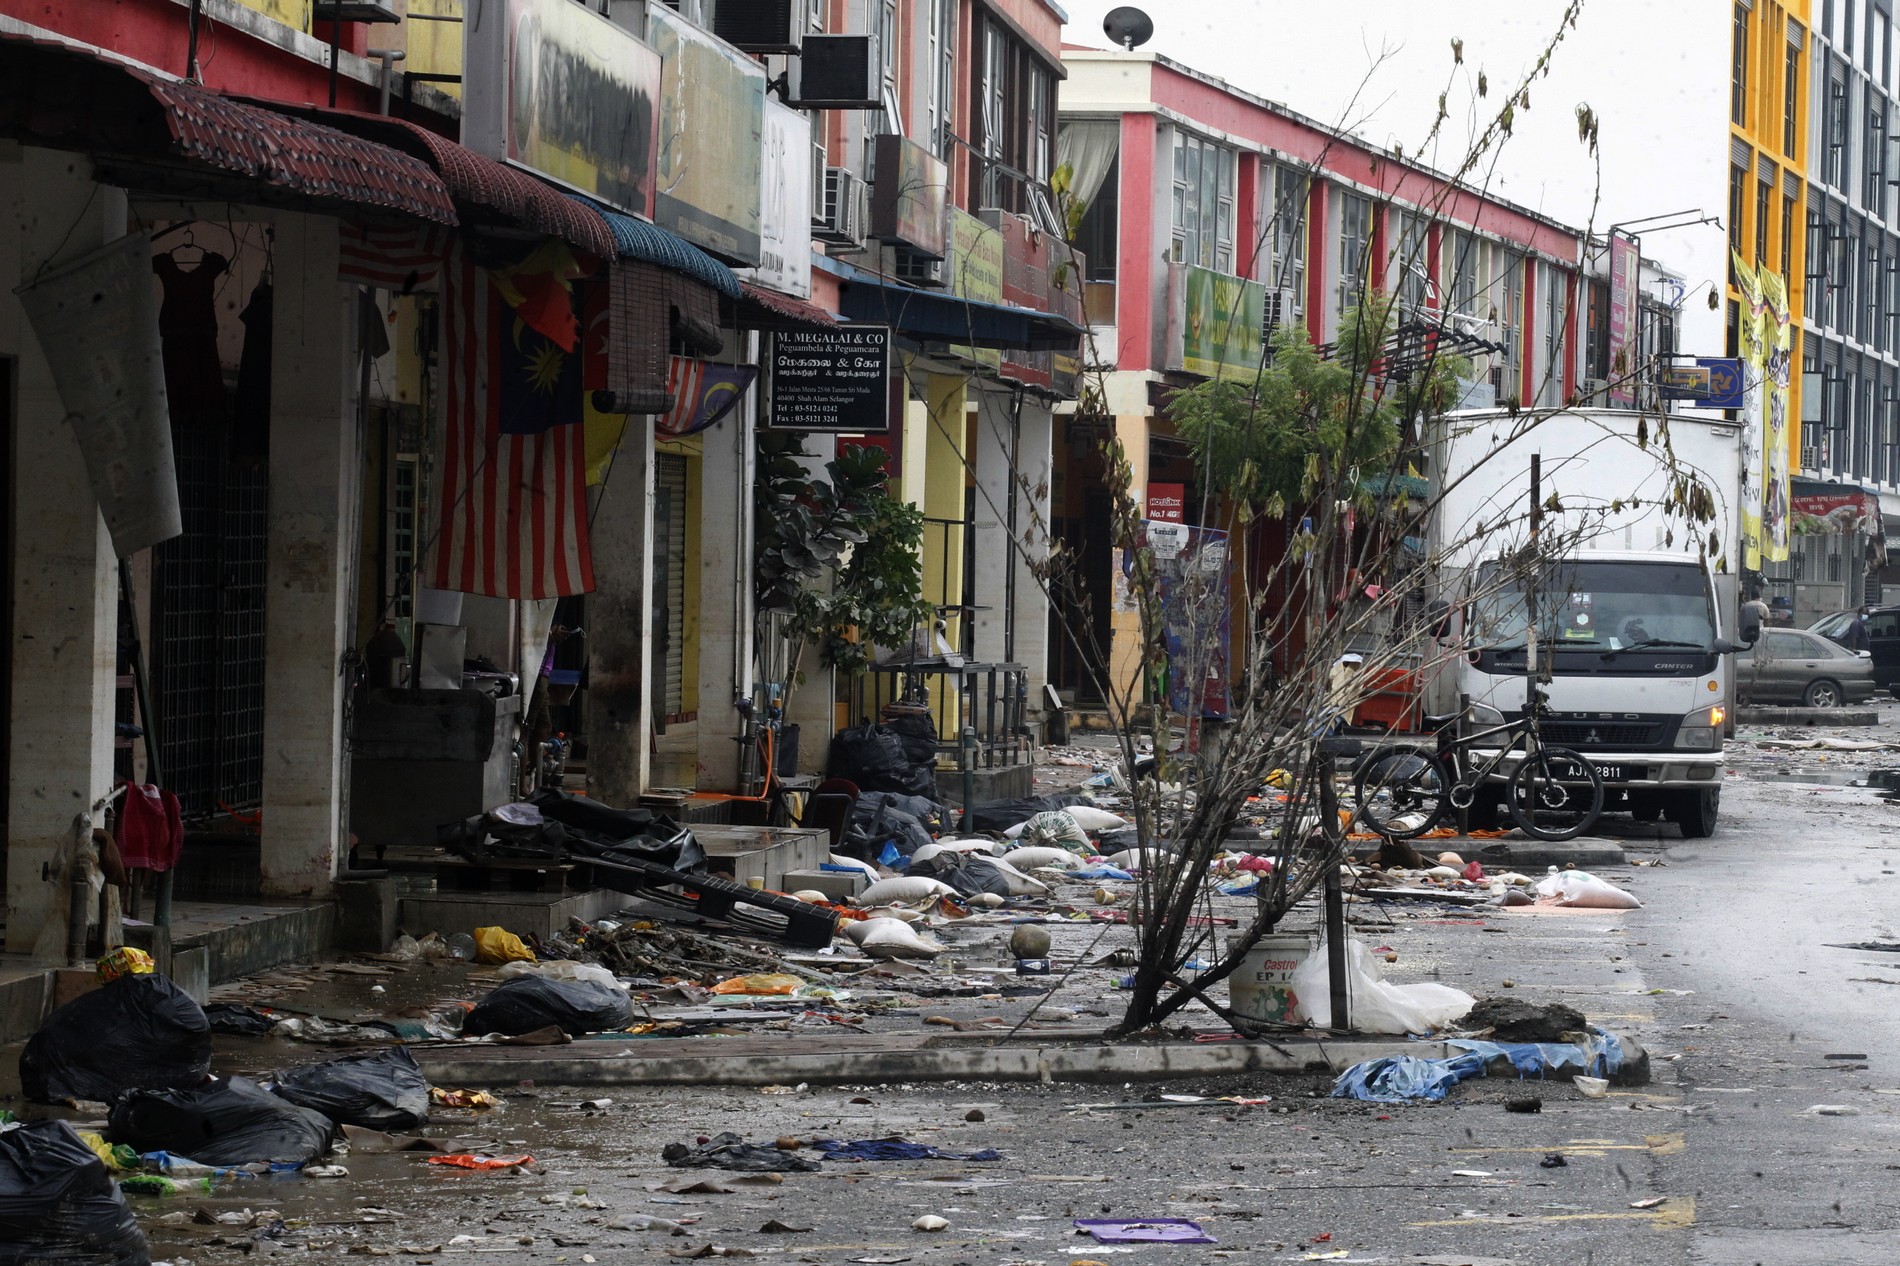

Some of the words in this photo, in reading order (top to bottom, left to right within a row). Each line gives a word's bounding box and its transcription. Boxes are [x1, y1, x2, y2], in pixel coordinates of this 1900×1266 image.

[778, 332, 792, 343] M.
[794, 332, 851, 344] MEGALAI
[853, 333, 863, 344] &
[866, 333, 884, 345] CO
[779, 343, 824, 354] Peguambela
[825, 344, 833, 353] &
[835, 344, 880, 355] Peguamcara
[836, 357, 850, 368] &
[854, 357, 881, 368] கோ
[825, 369, 833, 377] &
[829, 396, 855, 404] Selangor
[777, 404, 787, 412] Tel
[794, 404, 821, 412] 03-5124
[777, 414, 789, 422] Fax
[822, 415, 838, 423] 3241
[1149, 510, 1165, 518] No.1
[1547, 711, 1640, 719] FUSO
[1595, 766, 1620, 778] 2811
[1263, 959, 1298, 970] Castrol
[1256, 972, 1275, 981] EP
